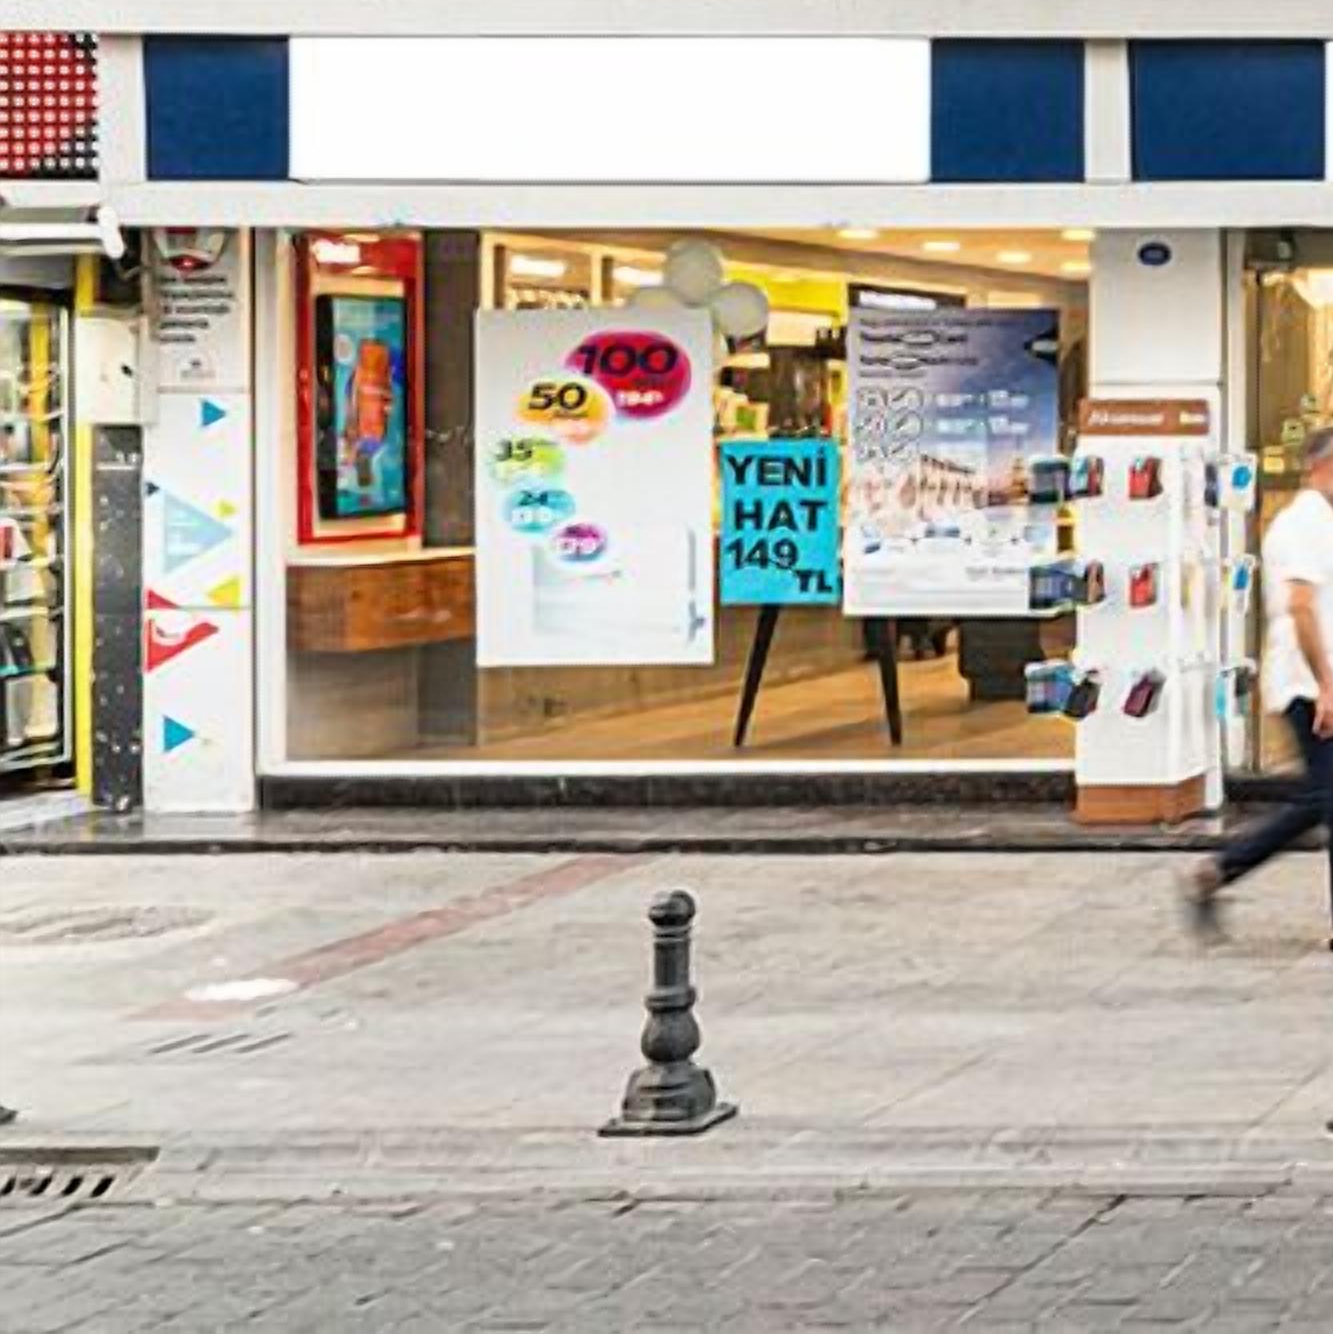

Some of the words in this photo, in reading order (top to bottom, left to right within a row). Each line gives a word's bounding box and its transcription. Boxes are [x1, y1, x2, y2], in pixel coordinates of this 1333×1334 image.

[574, 342, 679, 377] 100
[528, 380, 588, 411] 50
[734, 498, 828, 532] HAT
[726, 537, 799, 570] 149
[796, 569, 833, 593] TL
